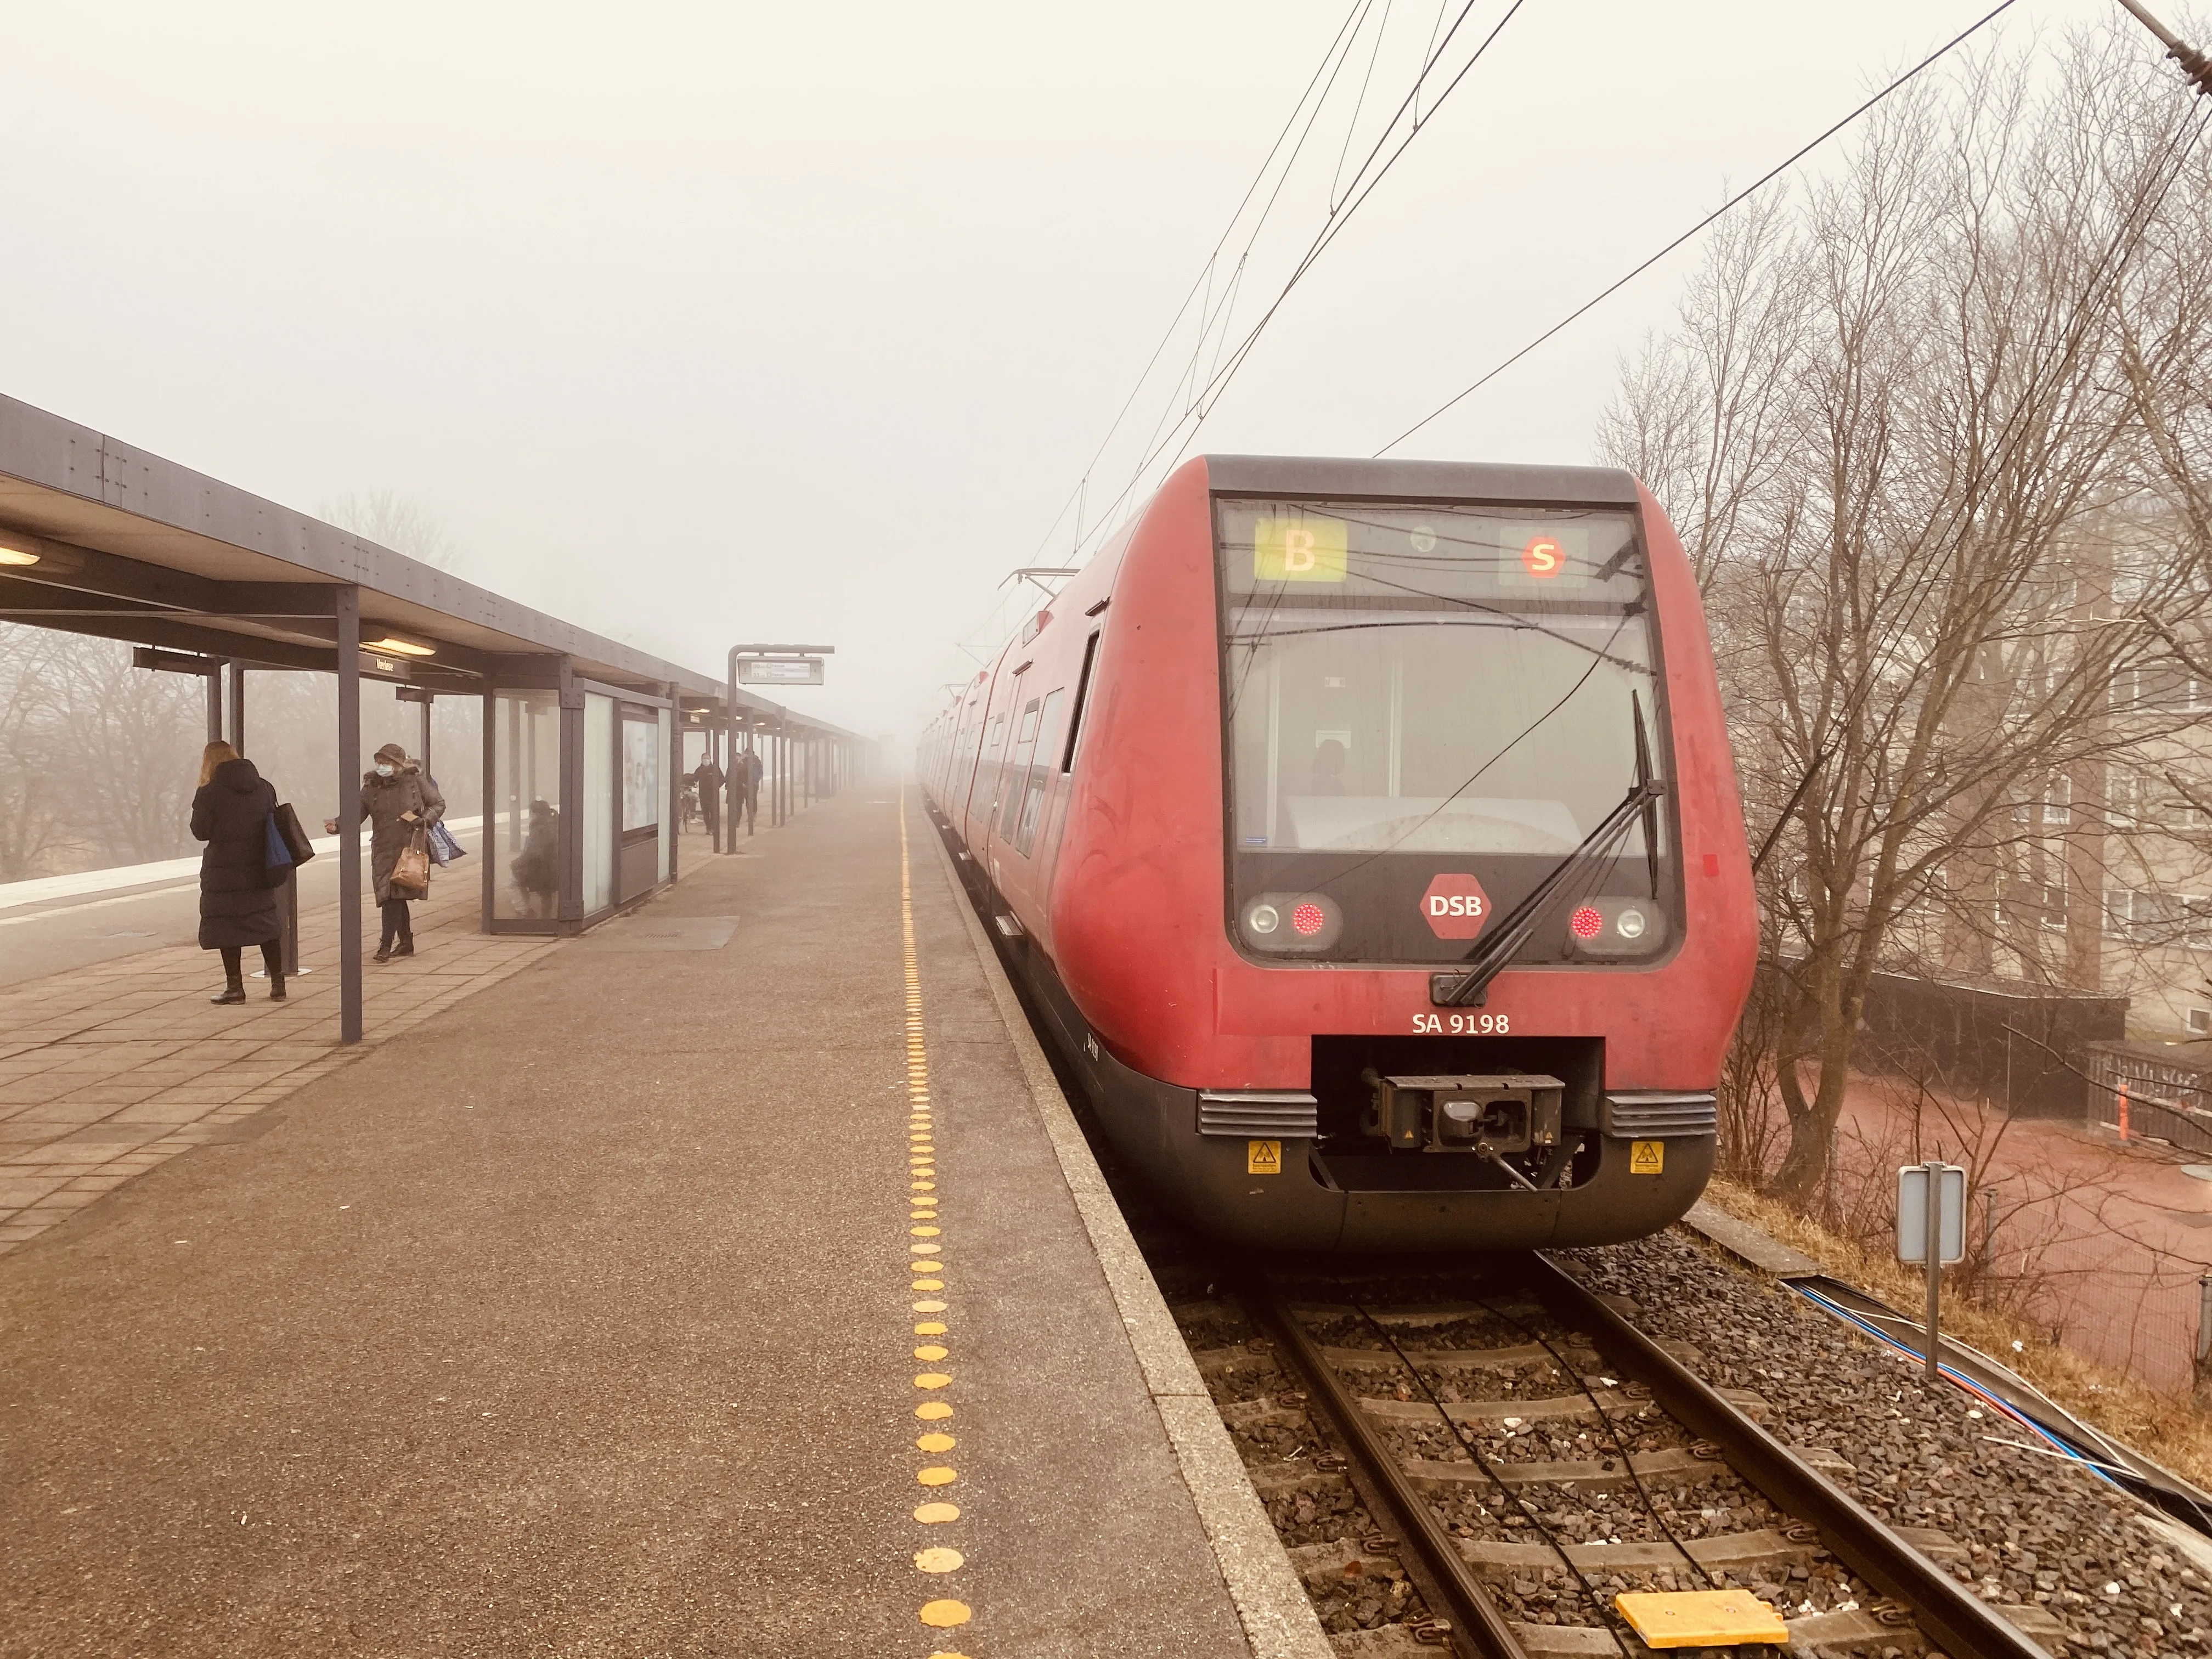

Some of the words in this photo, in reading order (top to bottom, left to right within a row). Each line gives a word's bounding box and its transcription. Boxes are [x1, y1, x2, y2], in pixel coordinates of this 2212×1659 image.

[1285, 529, 1316, 571] B
[1532, 544, 1555, 571] S
[1430, 895, 1482, 916] DSB
[1412, 1014, 1443, 1034] SA
[1449, 1014, 1510, 1034] 9198
